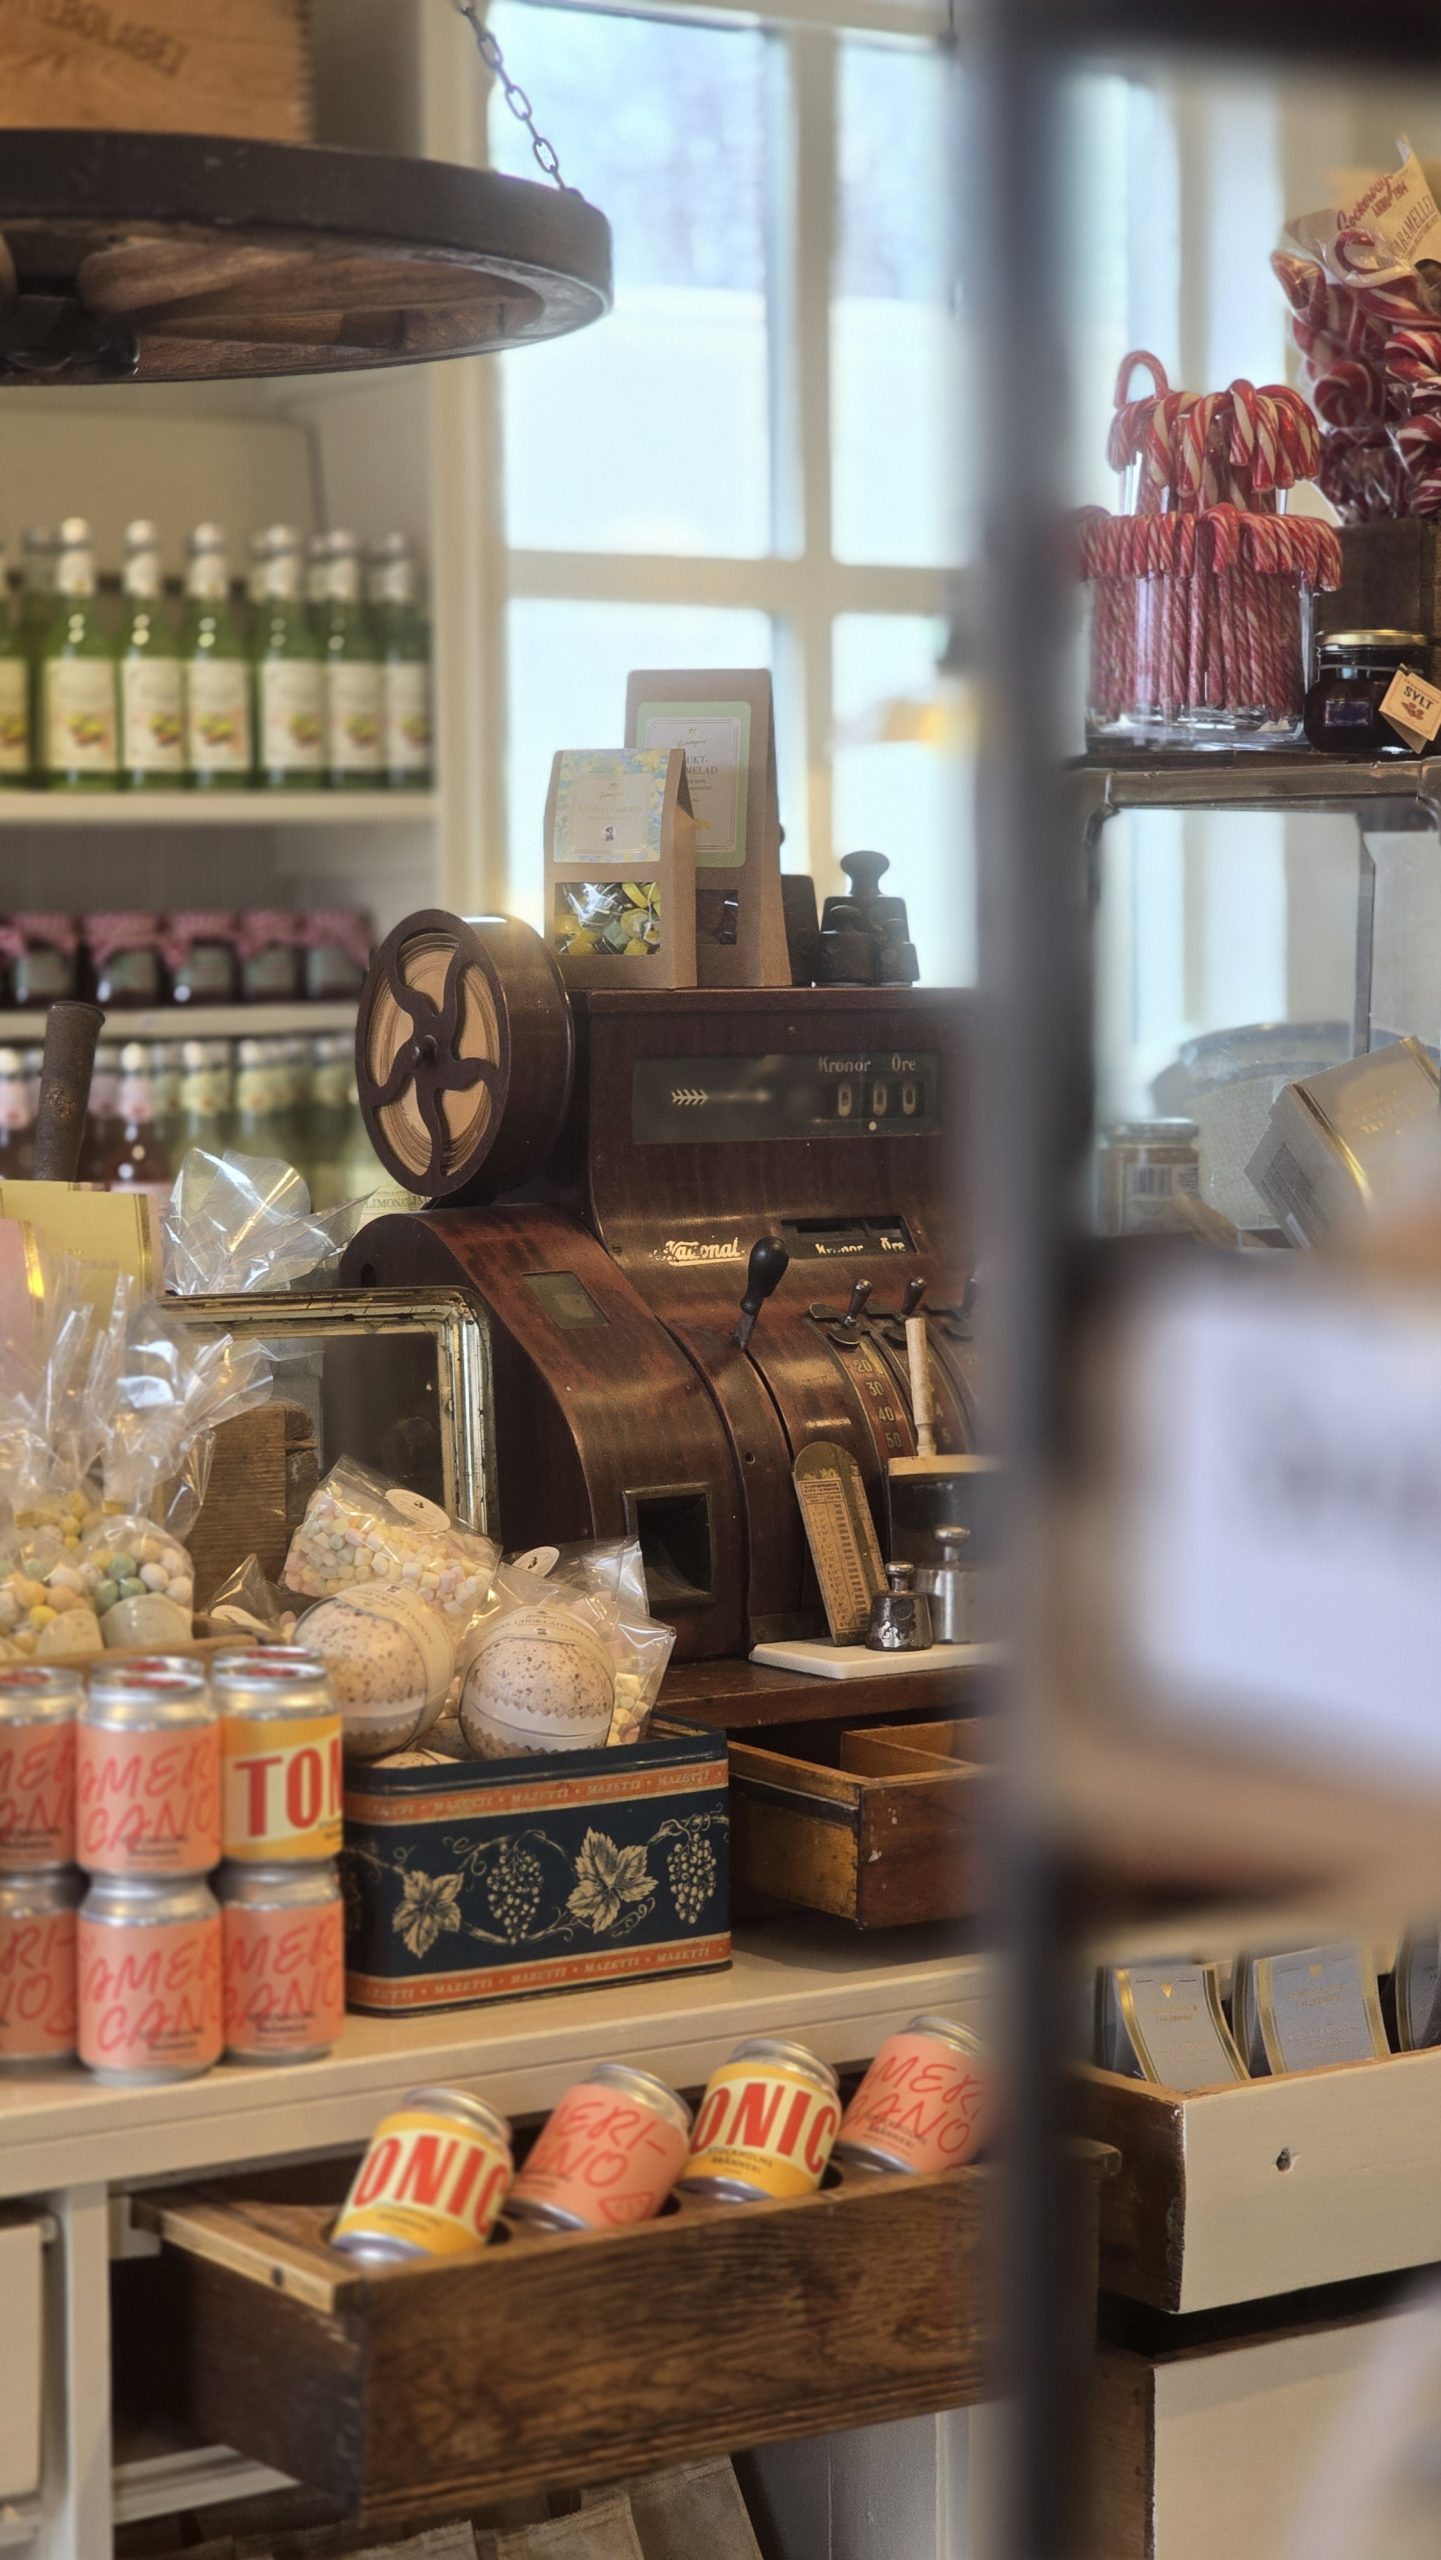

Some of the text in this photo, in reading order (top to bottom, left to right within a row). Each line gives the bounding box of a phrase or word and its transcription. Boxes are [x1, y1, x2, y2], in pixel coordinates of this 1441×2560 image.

[1403, 685, 1434, 710] SYLT
[818, 1052, 918, 1073] Kronor Öre
[853, 1359, 874, 1374] 20
[866, 1381, 884, 1397] 30
[878, 1407, 896, 1422] 40
[885, 1432, 905, 1449] 50
[658, 1770, 710, 1786] MAZETTI
[511, 1788, 569, 1803] MAZETTI
[586, 1780, 641, 1795] MAZETTI
[656, 1947, 711, 1963] MAZETTI
[583, 1956, 640, 1973] MAZETTI
[511, 1967, 567, 1984] MAZETTI
[433, 1978, 493, 1995] MAZETTI
